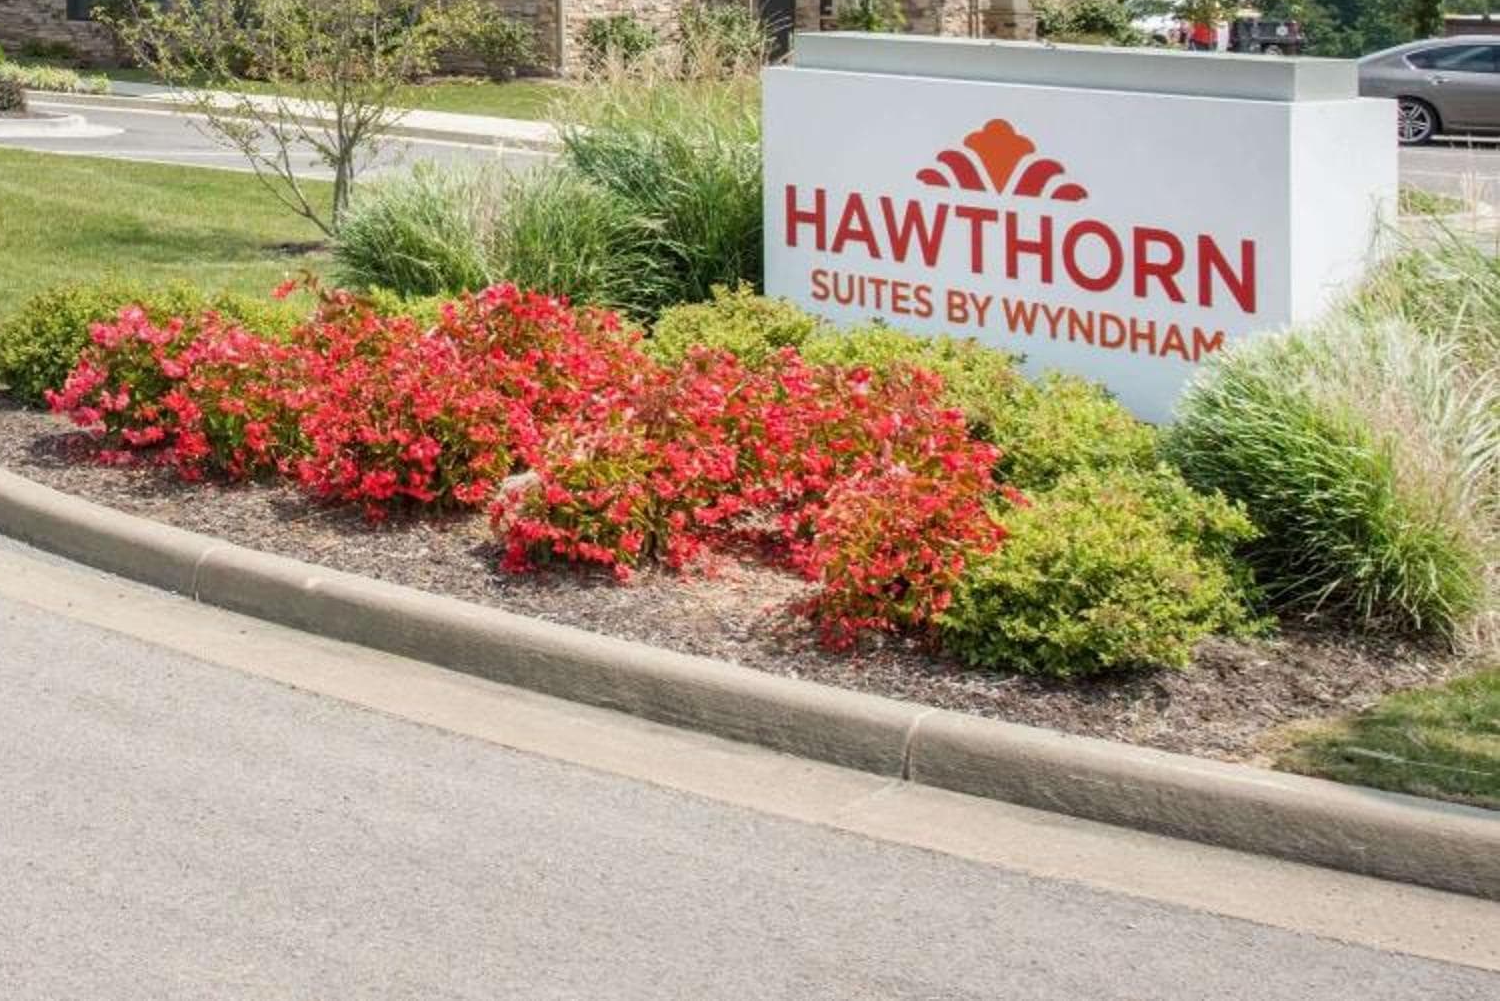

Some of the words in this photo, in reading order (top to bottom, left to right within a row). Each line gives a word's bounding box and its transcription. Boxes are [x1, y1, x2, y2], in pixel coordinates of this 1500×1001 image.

[785, 184, 1257, 314] HAWTHORN
[811, 269, 933, 317] SUITES
[947, 290, 993, 327] BY
[1002, 298, 1225, 363] WYNDHAM
